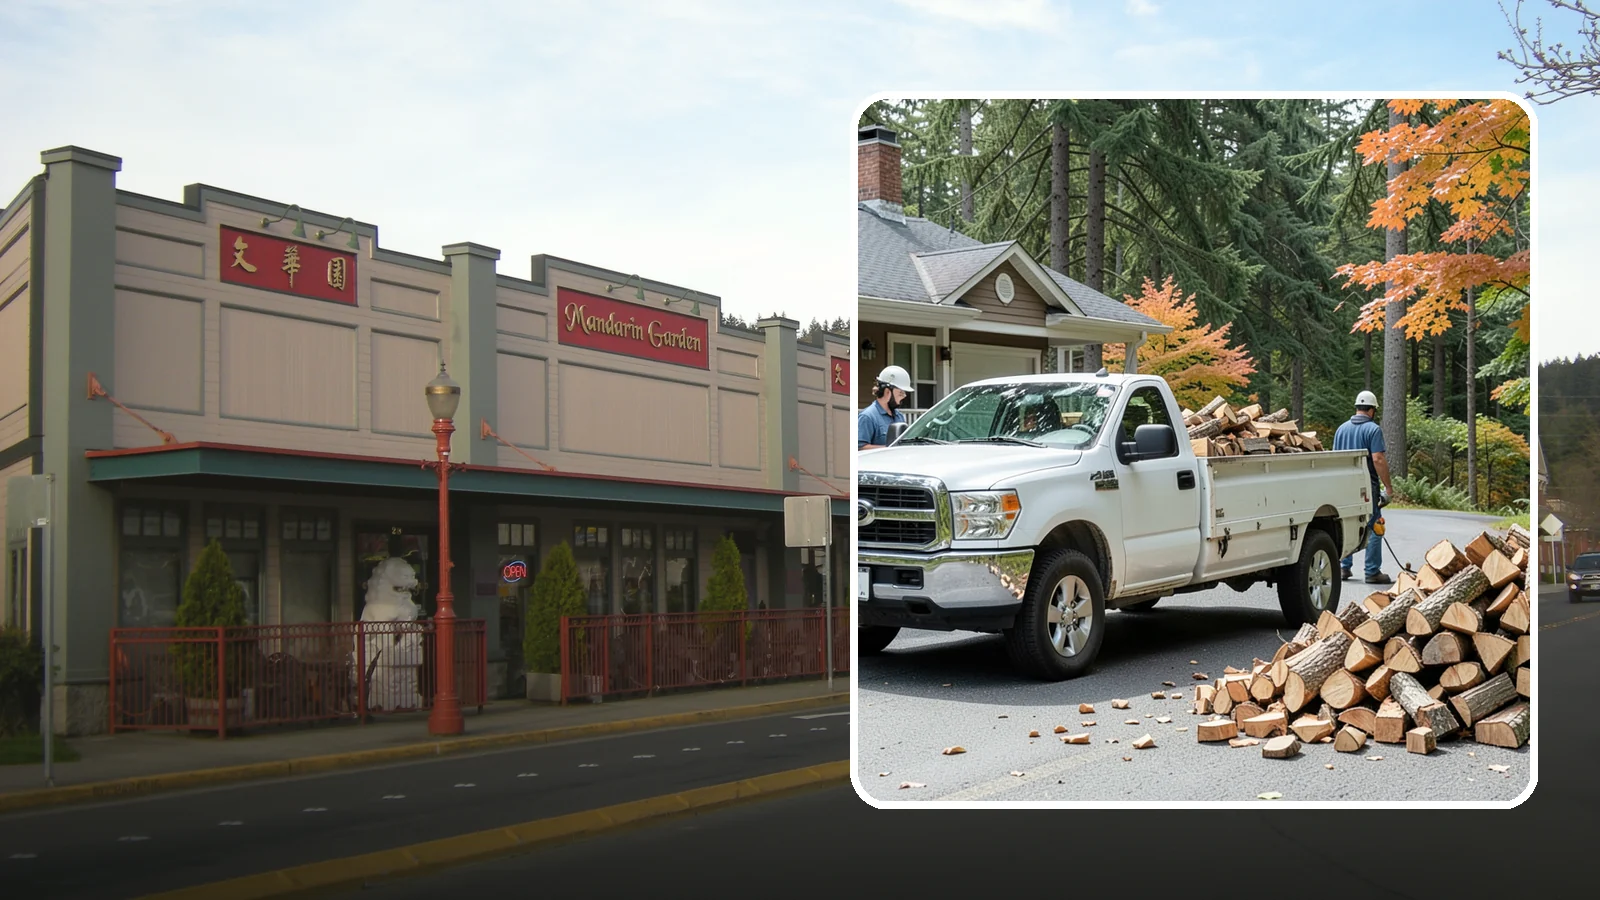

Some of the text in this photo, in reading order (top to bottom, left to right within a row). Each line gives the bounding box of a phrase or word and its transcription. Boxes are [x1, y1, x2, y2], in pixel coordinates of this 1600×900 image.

[231, 235, 346, 291] 文華園
[564, 302, 701, 352] Mandarin Garden
[503, 565, 527, 578] OPEN
